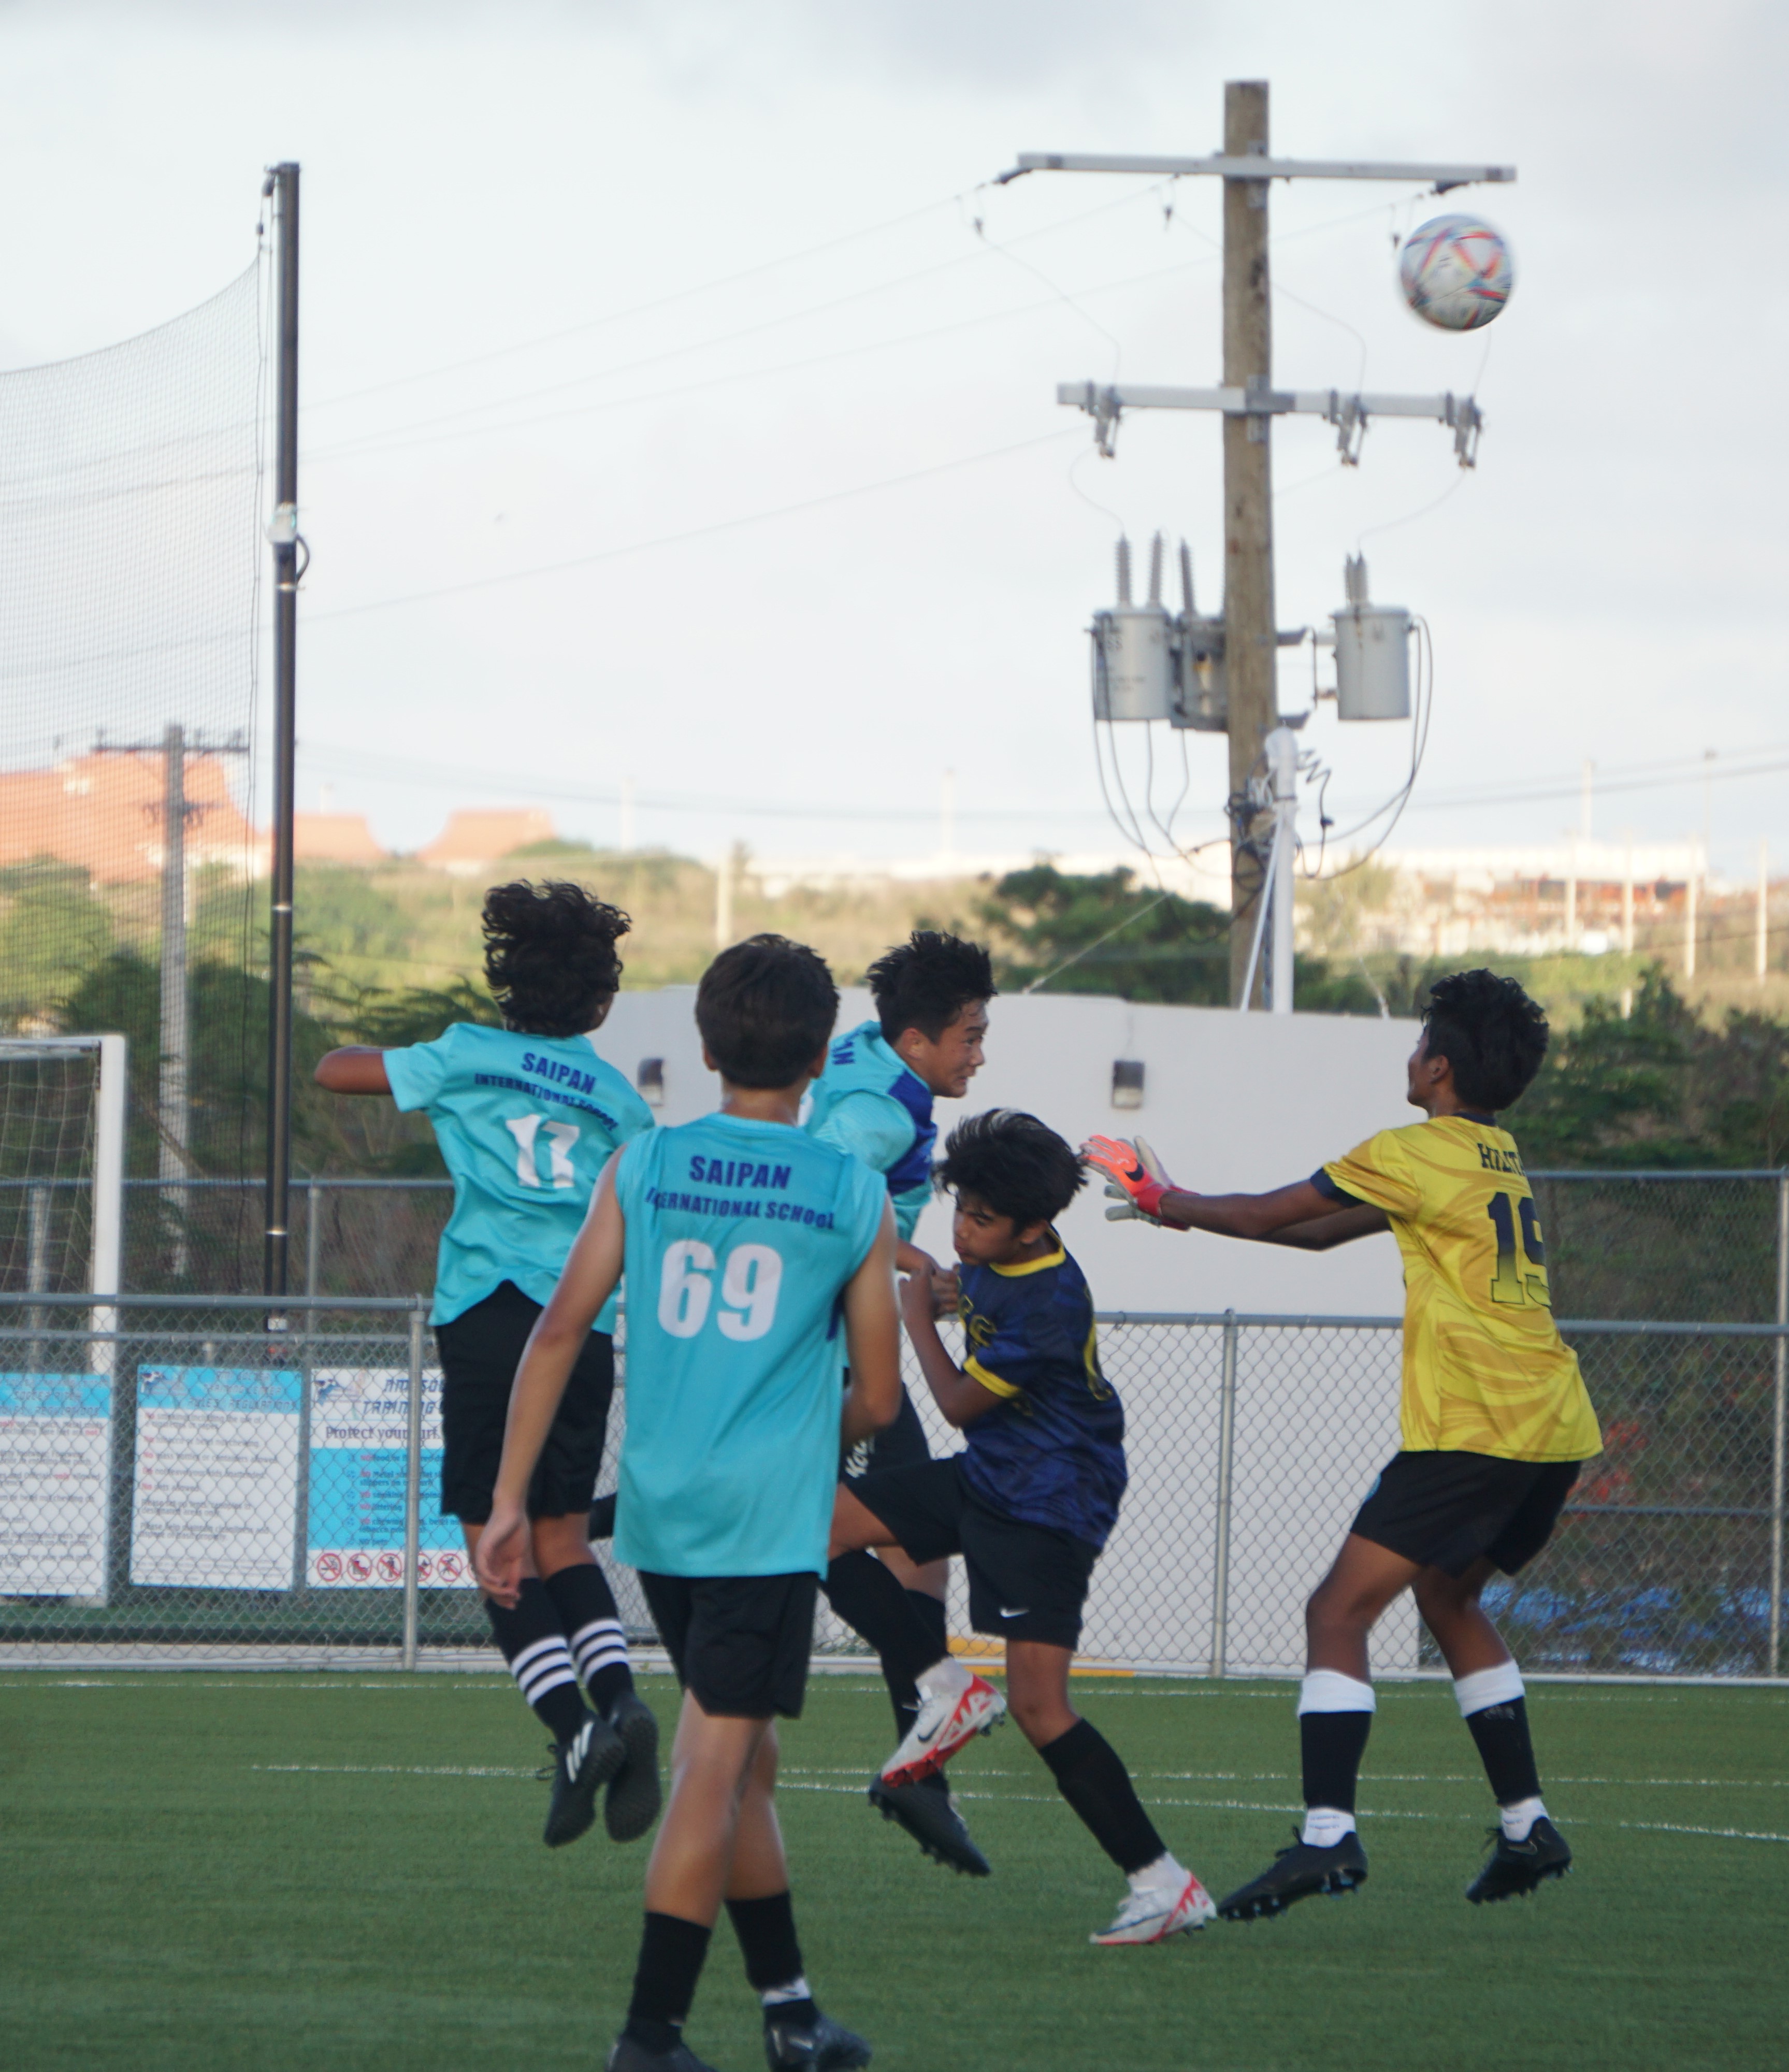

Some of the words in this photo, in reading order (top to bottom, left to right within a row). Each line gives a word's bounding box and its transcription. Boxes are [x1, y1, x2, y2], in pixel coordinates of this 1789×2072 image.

[521, 1052, 597, 1095] SAIPAN
[689, 1155, 792, 1190] SAIPAN
[764, 1202, 835, 1230] SCHOOL
[657, 1239, 783, 1342] 69
[326, 1426, 374, 1439] Protect
